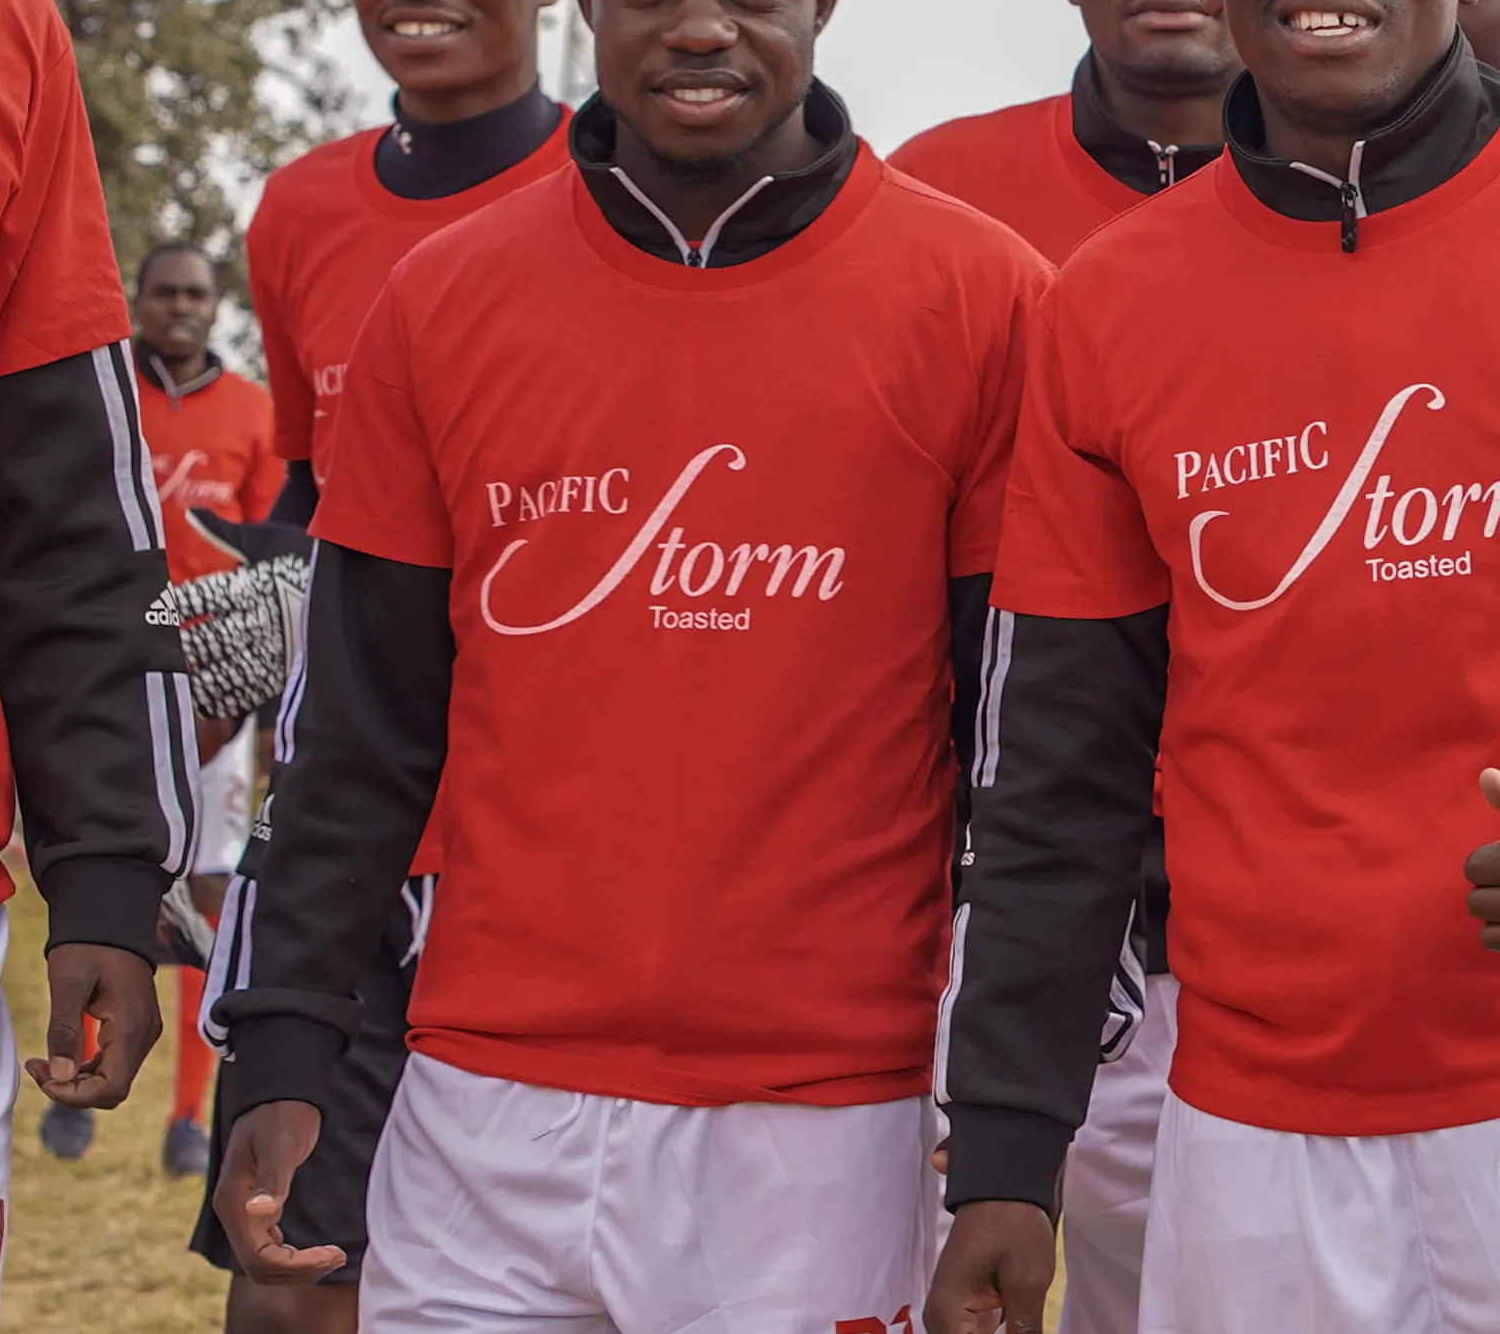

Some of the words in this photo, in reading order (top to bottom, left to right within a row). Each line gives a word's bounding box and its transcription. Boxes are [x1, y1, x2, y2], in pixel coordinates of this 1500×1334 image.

[1173, 421, 1329, 500] PACIFIC
[480, 443, 845, 635] Storm
[1364, 550, 1472, 582] Toasted
[144, 609, 180, 628] adid
[648, 606, 751, 631] Toasted
